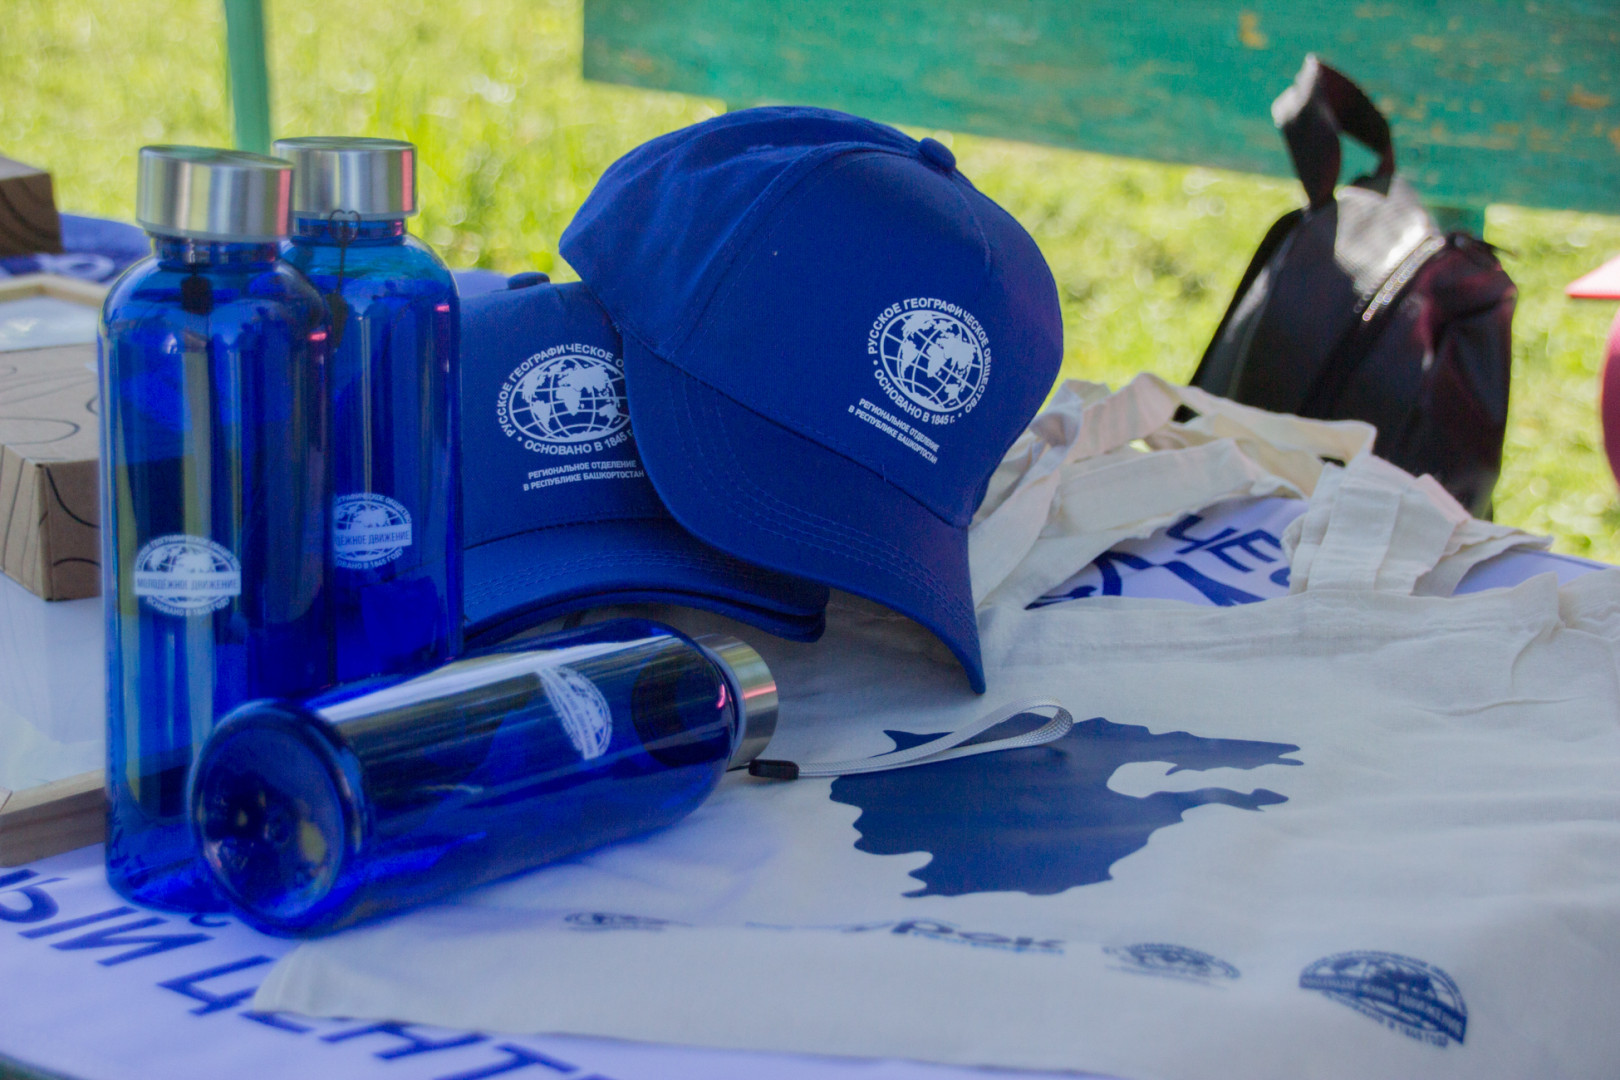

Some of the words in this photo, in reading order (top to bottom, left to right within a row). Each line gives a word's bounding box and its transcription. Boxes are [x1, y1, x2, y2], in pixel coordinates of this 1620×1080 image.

[868, 302, 901, 355] РУССКОЕ
[903, 297, 989, 347] ГЕОГРАФИЧЕСКОЕ
[965, 347, 991, 413] ОБЩЕСТВО
[496, 382, 517, 437] РУССКОЕ
[509, 343, 614, 382] ГЕОГРАФИЧЕСКОЕ
[874, 369, 923, 419] ОСНОВАНО
[922, 411, 930, 423] В
[931, 414, 949, 425] 1845
[524, 439, 592, 455] ОСНОВАНО
[593, 441, 604, 452] В
[604, 431, 628, 448] 1845
[848, 405, 855, 413] В
[855, 408, 899, 438] РЕСПУБЛИКЕ
[897, 432, 938, 464] БАШКОРТОСТАН
[859, 398, 911, 433] РЕГИОНАЛЬНОЕ
[909, 427, 940, 453] ОТДЕЛЕНИЕ
[523, 483, 530, 492] В
[531, 473, 582, 490] РЕСПУБЛИКЕ
[583, 470, 645, 481] БАШКОРТОСТАН
[528, 462, 590, 480] РЕГИОНАЛЬНОЕ
[591, 460, 637, 470] ОТДЕЛЕНИЕ
